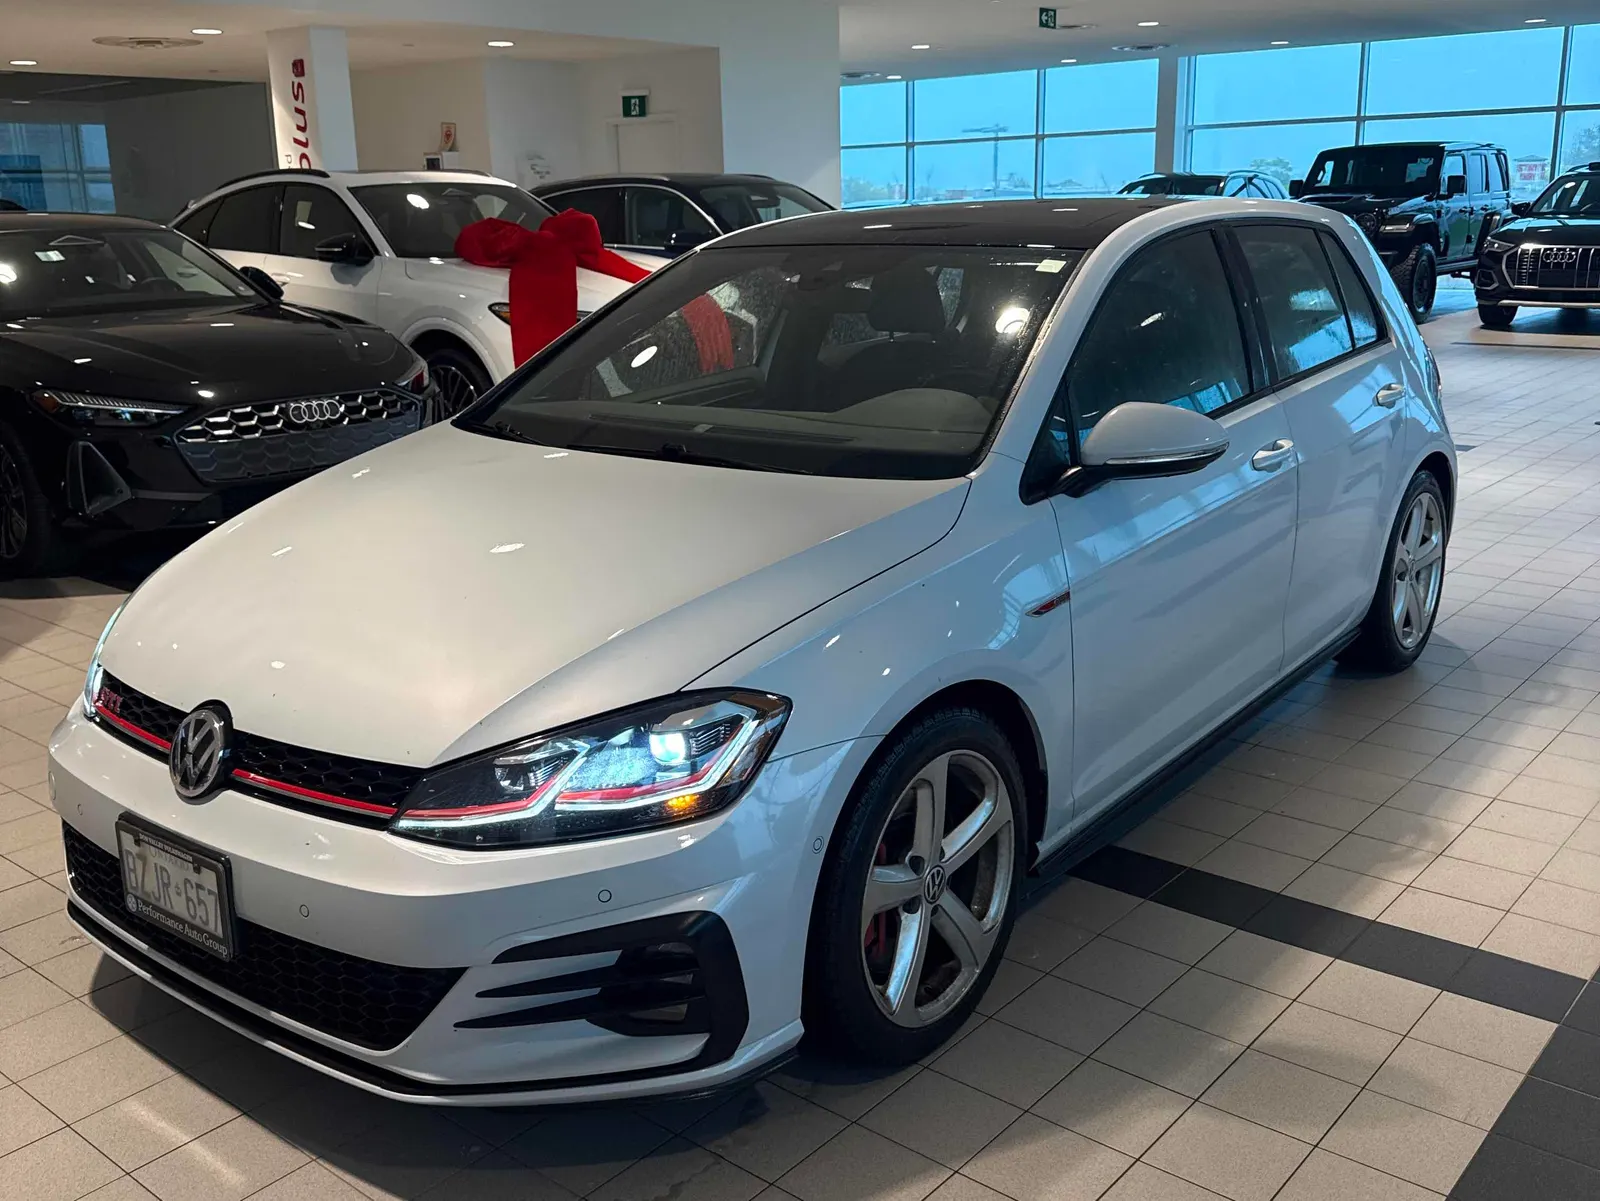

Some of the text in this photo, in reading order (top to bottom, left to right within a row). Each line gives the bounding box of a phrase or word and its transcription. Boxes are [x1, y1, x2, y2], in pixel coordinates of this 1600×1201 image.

[125, 850, 219, 934] BZJR 657
[137, 900, 228, 957] Performance Auto Group
